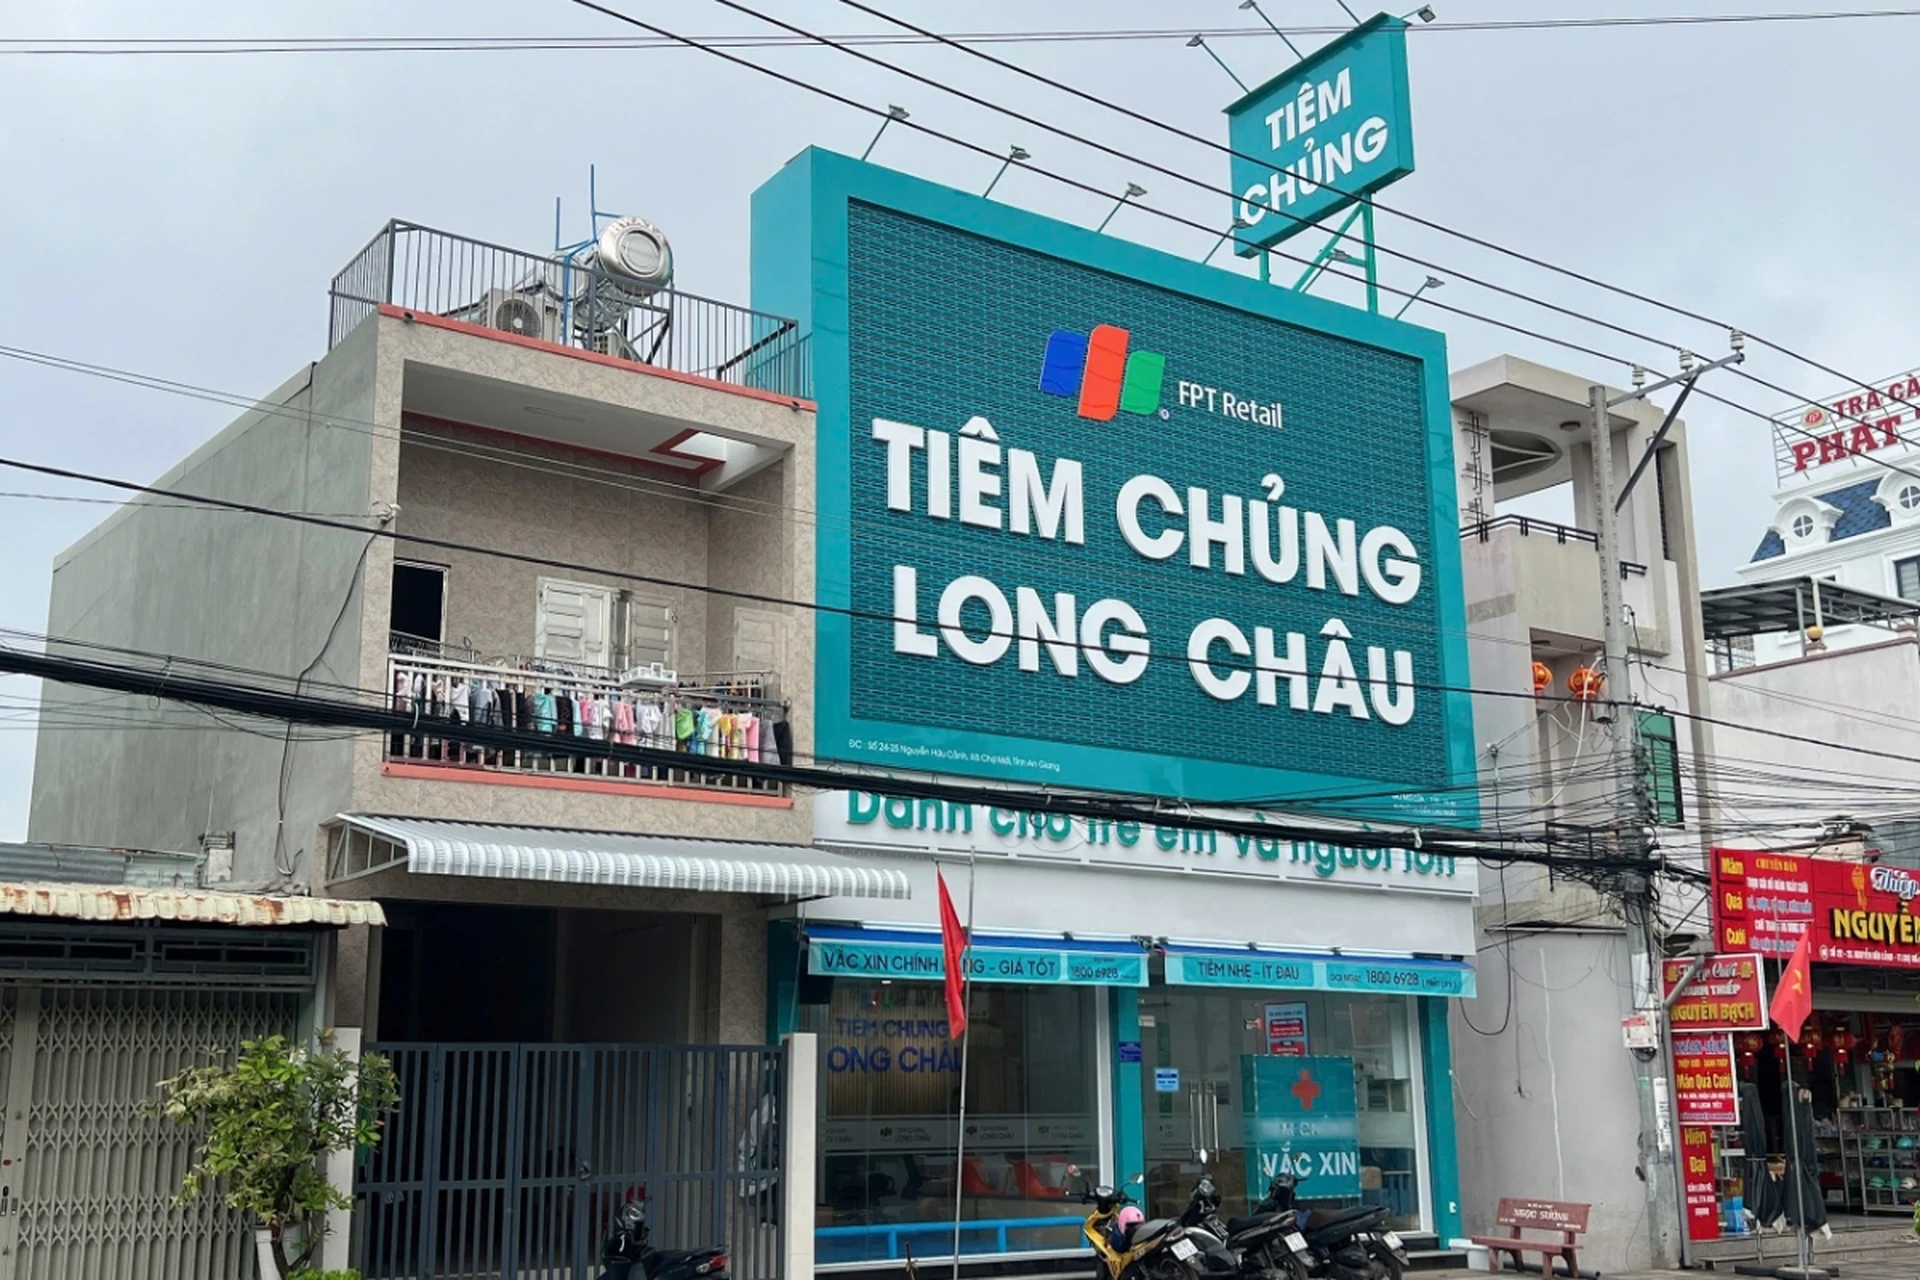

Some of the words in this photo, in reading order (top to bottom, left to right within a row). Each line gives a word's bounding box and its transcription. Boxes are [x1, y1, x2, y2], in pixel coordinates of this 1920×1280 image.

[1265, 67, 1352, 151] TIÊM
[1239, 116, 1388, 226] CHỦNG
[1178, 380, 1217, 413] FPT
[1223, 392, 1283, 429] Retail
[1792, 415, 1902, 472] PHÁT
[872, 415, 1085, 545] TIÊM
[1116, 473, 1421, 604] CHỦNG
[893, 564, 1150, 684] LONG
[1187, 617, 1416, 726] CHÂU
[824, 947, 859, 969] VẮC
[863, 956, 888, 972] XIN
[892, 952, 938, 973] CHÍNH
[999, 955, 1025, 975] GIÁ
[1029, 956, 1056, 977] TỐT
[1096, 966, 1119, 979] 6928
[1198, 958, 1225, 977] TIÊM
[1228, 962, 1251, 983] NHẸ
[1276, 965, 1299, 981] ĐAU
[1366, 969, 1391, 984] 1800
[1393, 971, 1419, 986] 6928
[1671, 996, 1718, 1021] NGUYỄN
[1721, 1002, 1754, 1023] BẠCH
[1262, 1140, 1313, 1178] VẮC
[1319, 1151, 1358, 1177] XIN
